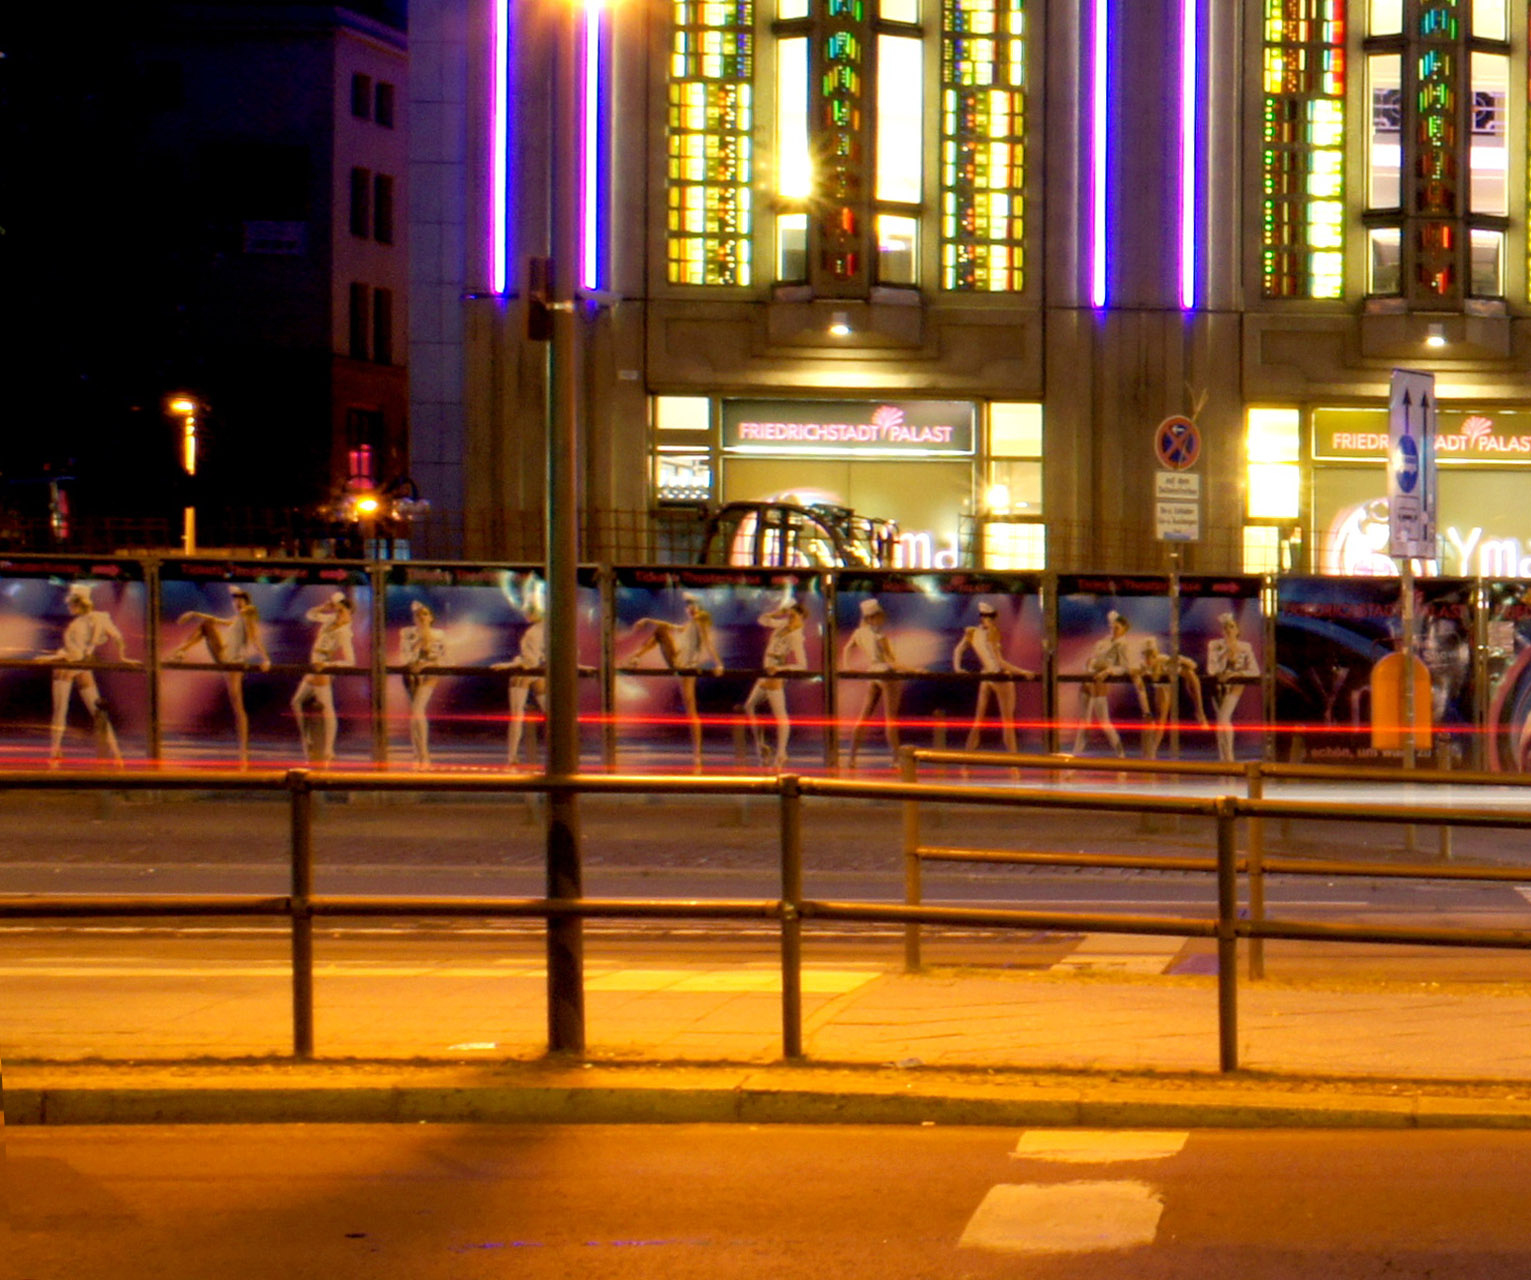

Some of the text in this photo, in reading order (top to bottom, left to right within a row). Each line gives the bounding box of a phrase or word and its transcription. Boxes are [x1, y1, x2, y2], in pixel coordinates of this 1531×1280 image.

[738, 422, 953, 443] FRIEDRICHSTADT PALAST
[1332, 432, 1468, 451] FRIEDRADT
